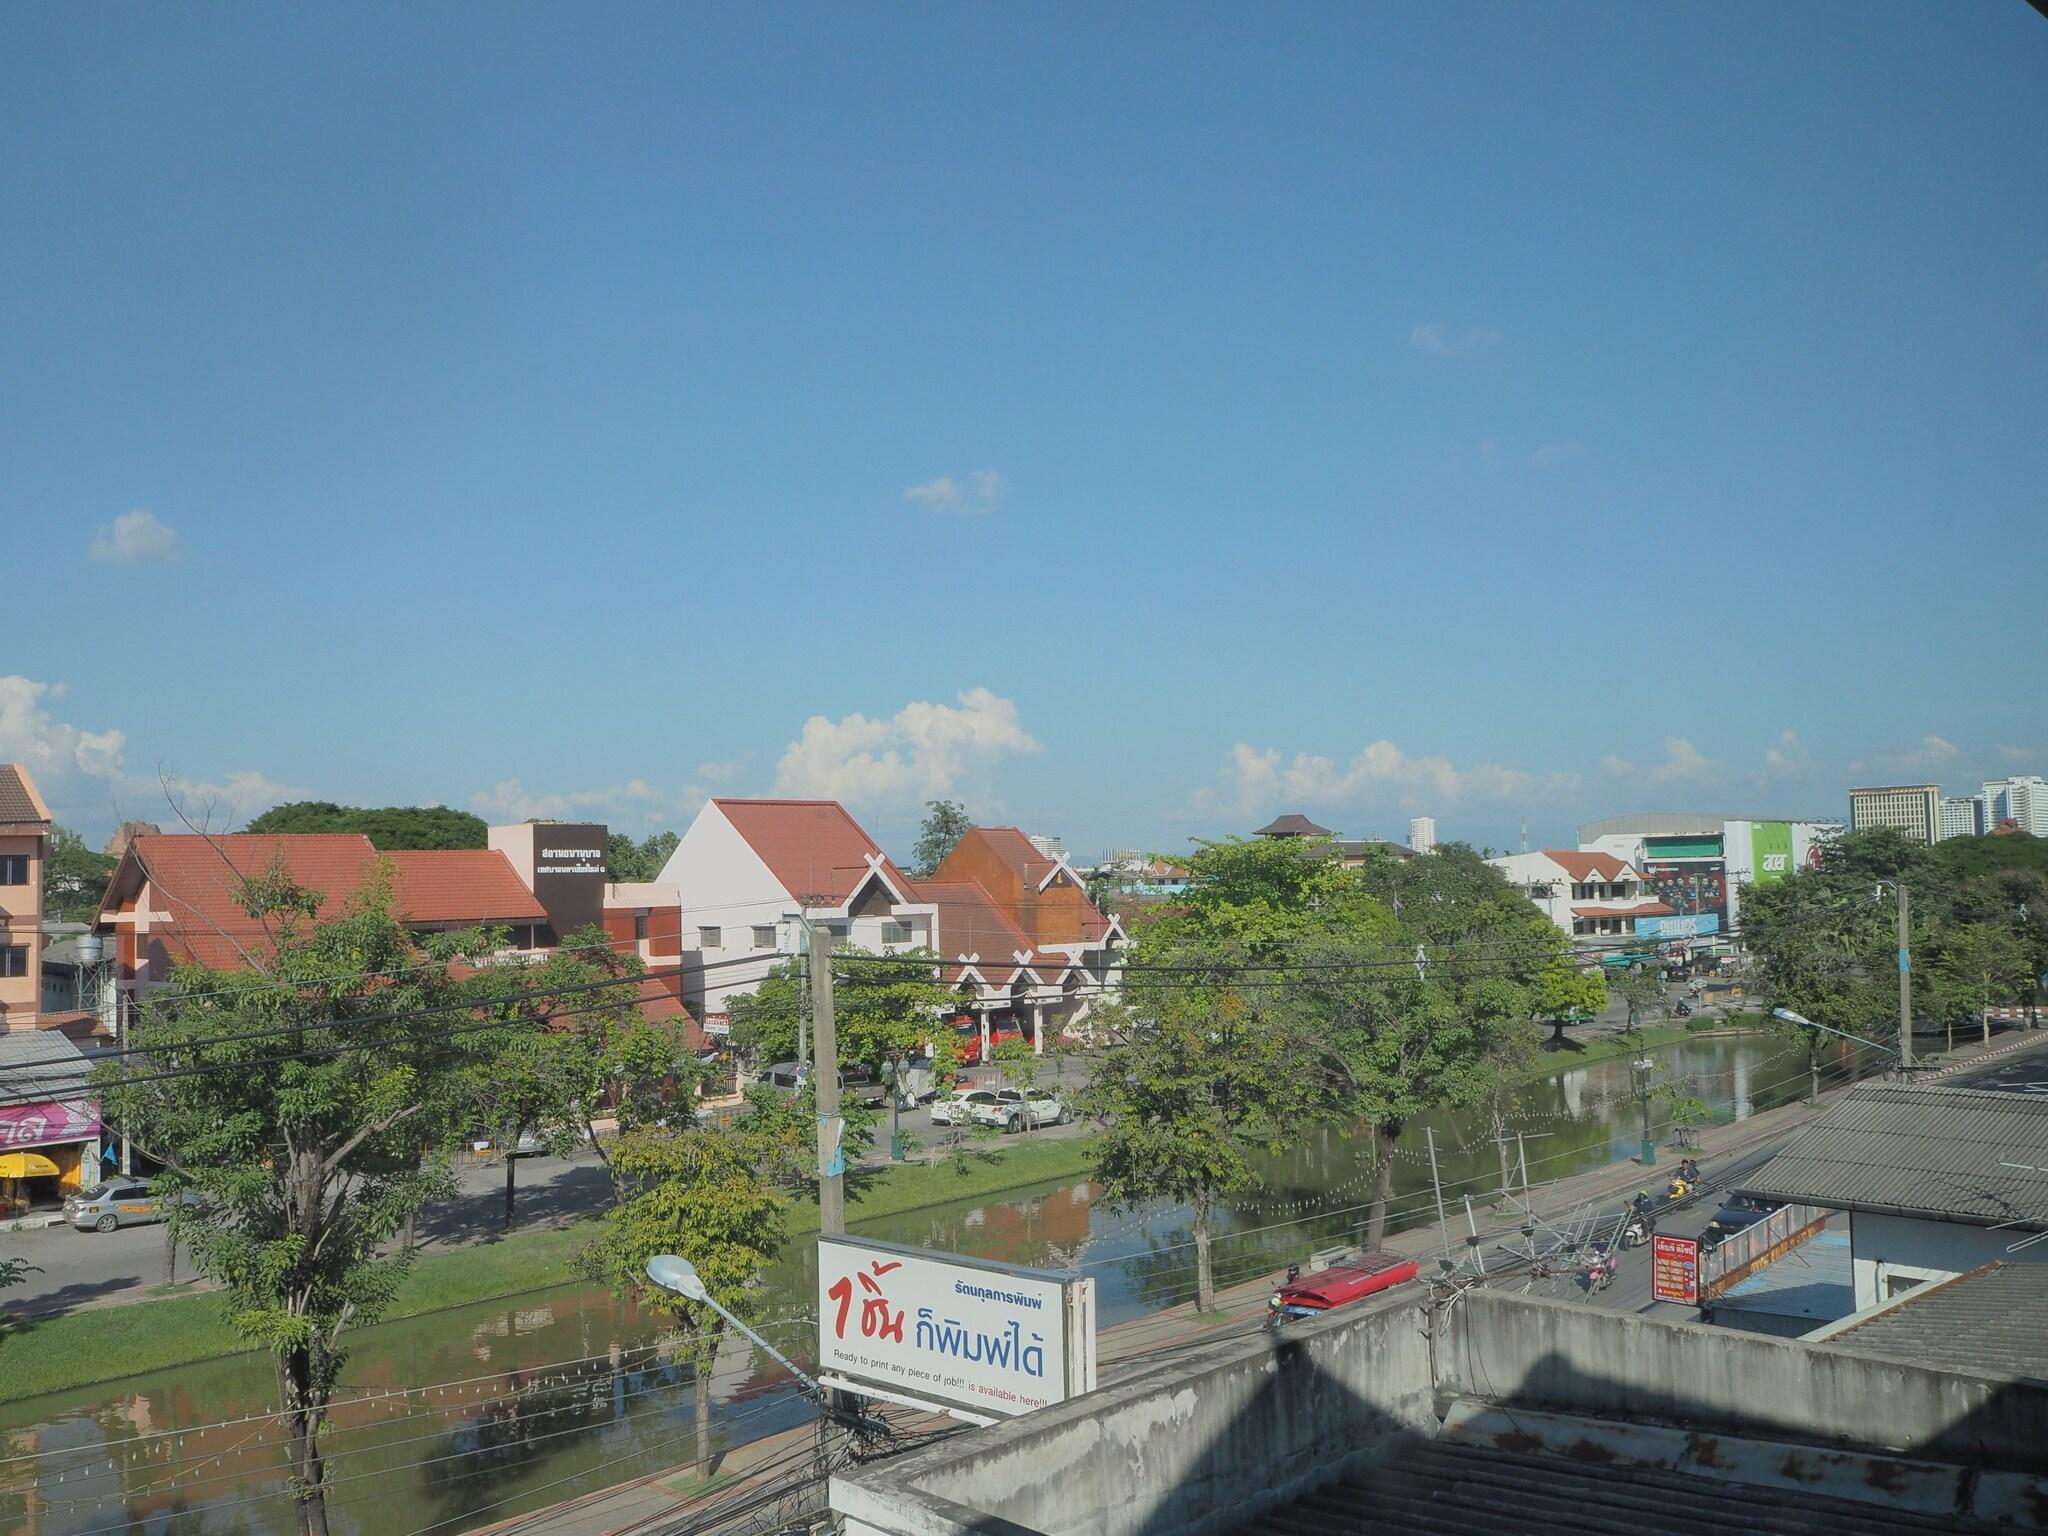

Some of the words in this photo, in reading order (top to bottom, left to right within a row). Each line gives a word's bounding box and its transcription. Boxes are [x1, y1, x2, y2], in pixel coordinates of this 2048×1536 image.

[1763, 854, 1788, 871] acer
[1659, 917, 1697, 936] PHILIPS
[916, 1307, 1044, 1378] ก็พิมพ์ได้
[834, 1348, 858, 1365] Ready
[860, 1355, 868, 1366] to
[871, 1358, 889, 1371] print
[891, 1363, 906, 1376] any
[908, 1366, 930, 1381] piece
[932, 1373, 941, 1384] of
[943, 1376, 965, 1389] job!!!
[968, 1381, 976, 1392] is
[978, 1383, 1017, 1403] available
